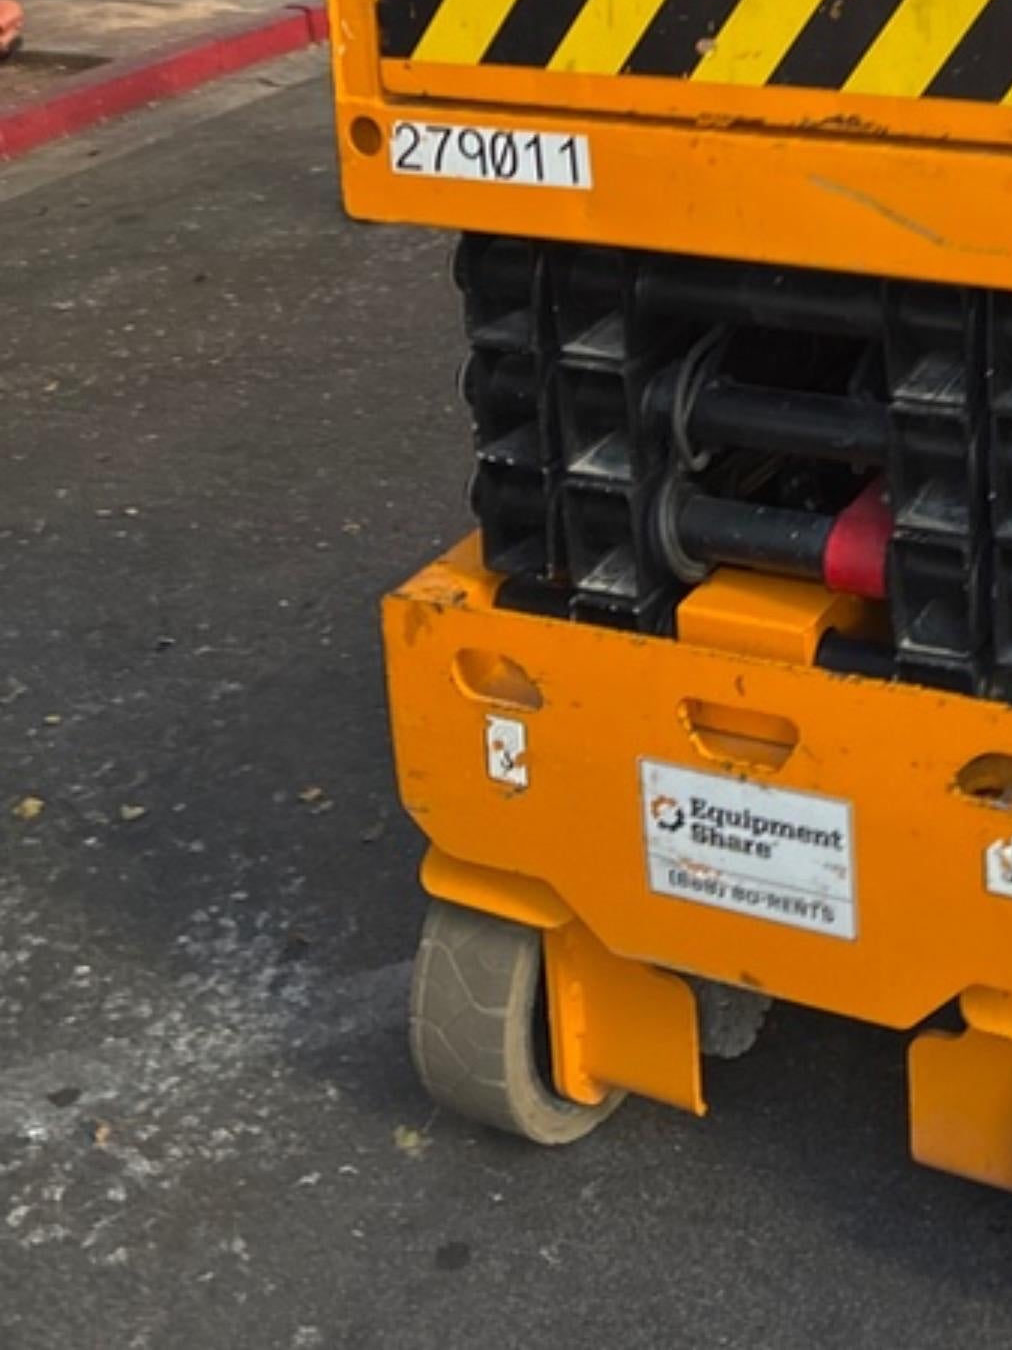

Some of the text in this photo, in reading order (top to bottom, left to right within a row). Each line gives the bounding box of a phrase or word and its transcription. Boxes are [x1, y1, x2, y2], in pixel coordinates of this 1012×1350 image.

[395, 122, 580, 185] 279011
[689, 796, 843, 851] Equipment
[690, 822, 772, 859] Share
